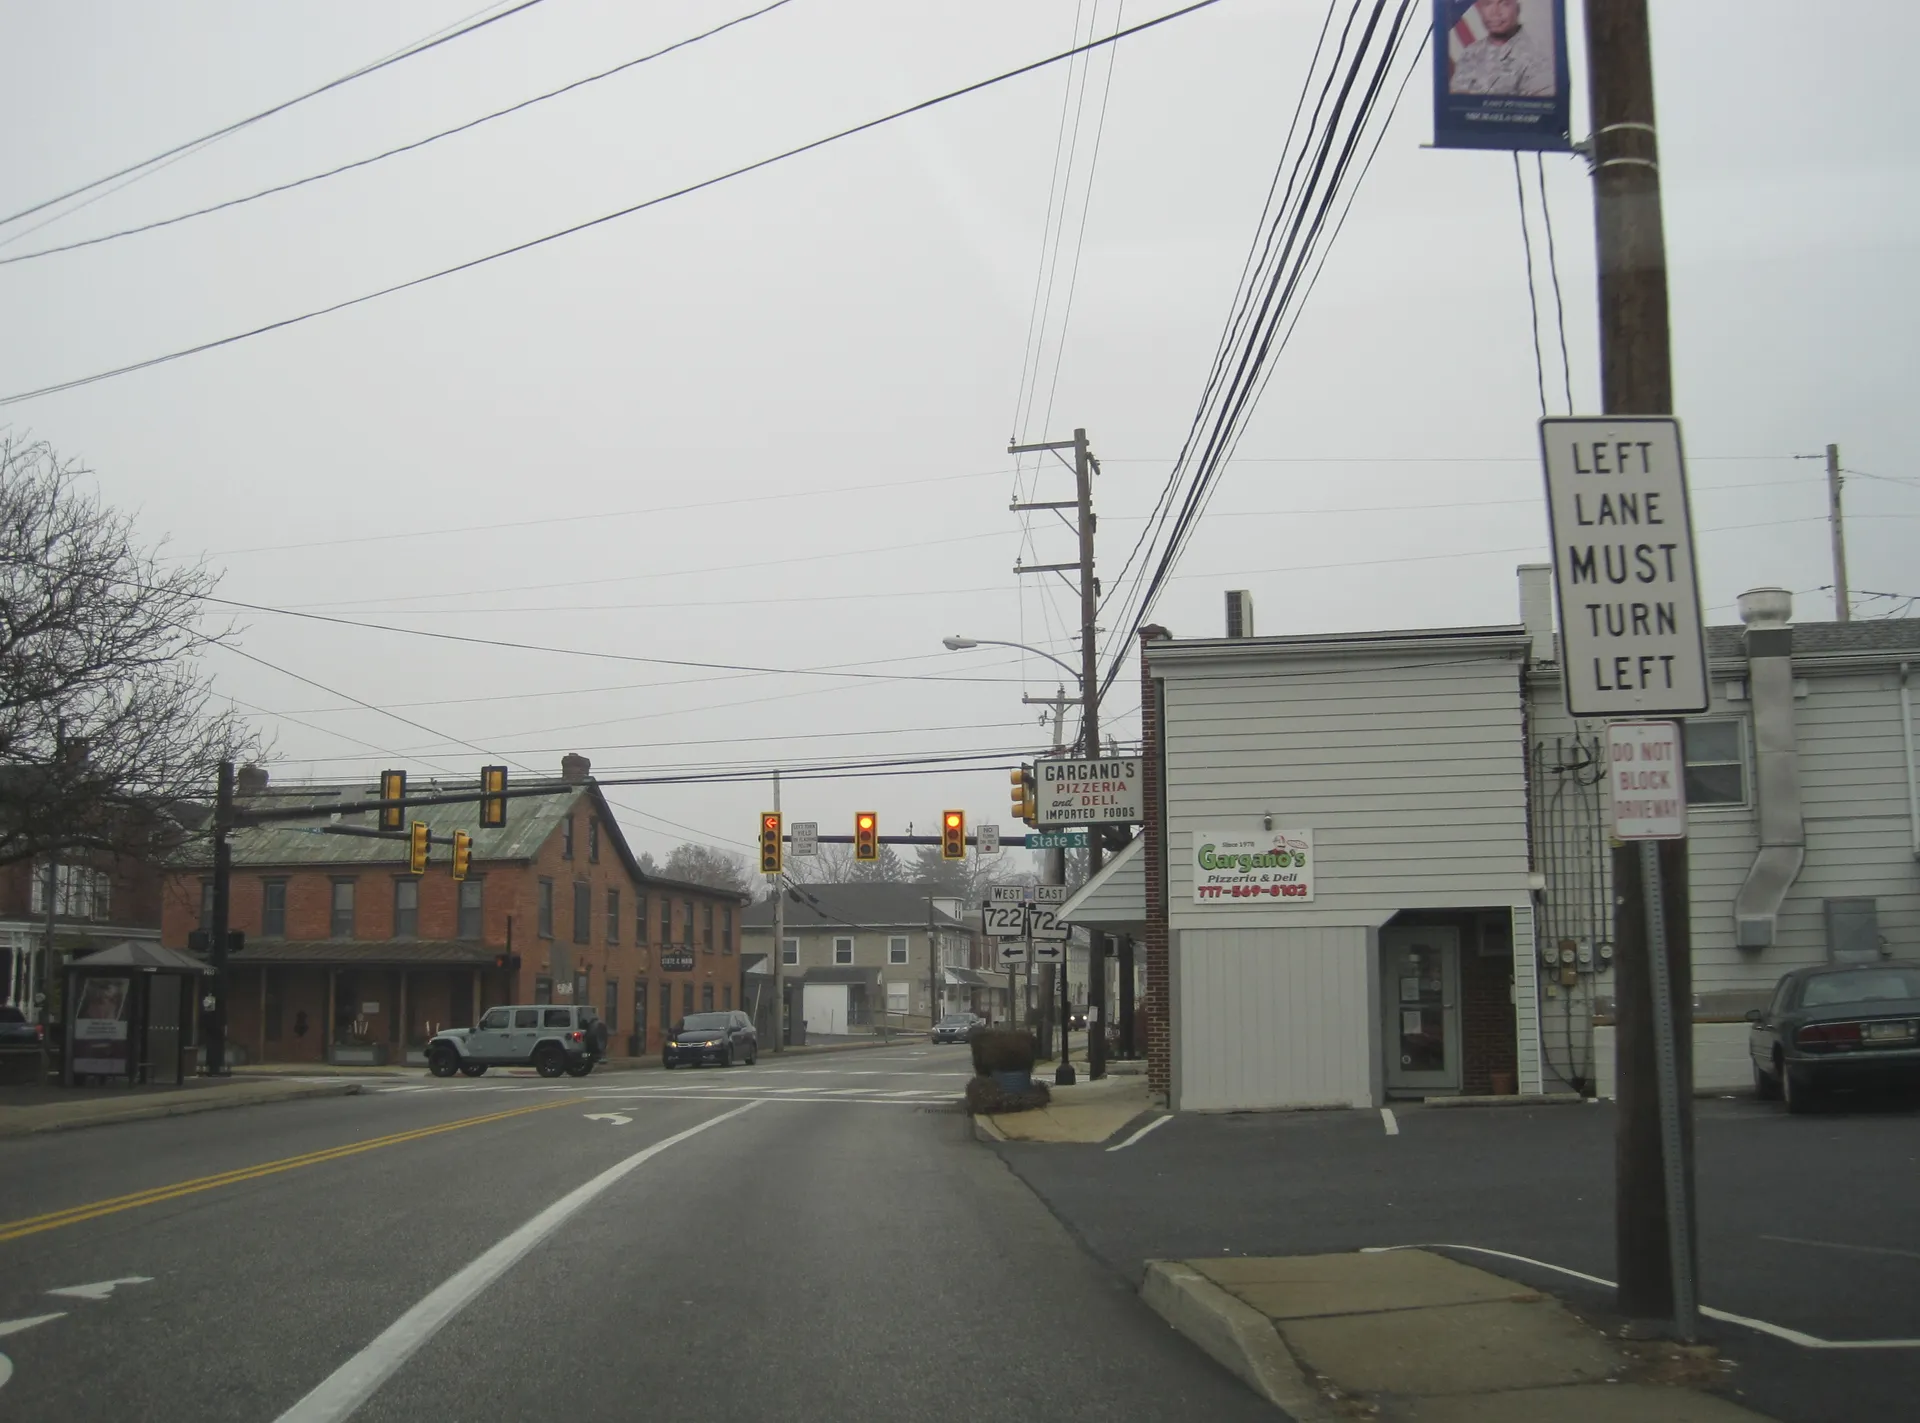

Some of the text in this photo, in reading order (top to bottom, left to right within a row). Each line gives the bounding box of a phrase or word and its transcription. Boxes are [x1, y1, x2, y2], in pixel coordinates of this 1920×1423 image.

[1572, 442, 1653, 474] LEFT
[1574, 493, 1664, 526] LANE
[1569, 544, 1677, 584] MUST
[1585, 602, 1676, 637] TURN
[1593, 655, 1675, 691] LEFT
[1612, 741, 1673, 761] DO NOT
[1045, 761, 1135, 781] GARGANO'S
[1619, 770, 1671, 790] BLOCK
[1056, 781, 1127, 794] PIZZERIA
[1052, 795, 1118, 807] and DELI.
[1616, 799, 1677, 819] DRIVEWAY
[1046, 806, 1135, 820] IMPORTED FOODS
[1031, 833, 1088, 848] State St
[1198, 843, 1306, 873] Gargano's
[1207, 873, 1298, 883] Pizzeria & Deli
[994, 887, 1021, 900] WEST
[1038, 887, 1063, 899] EAST
[984, 908, 1022, 927] 722
